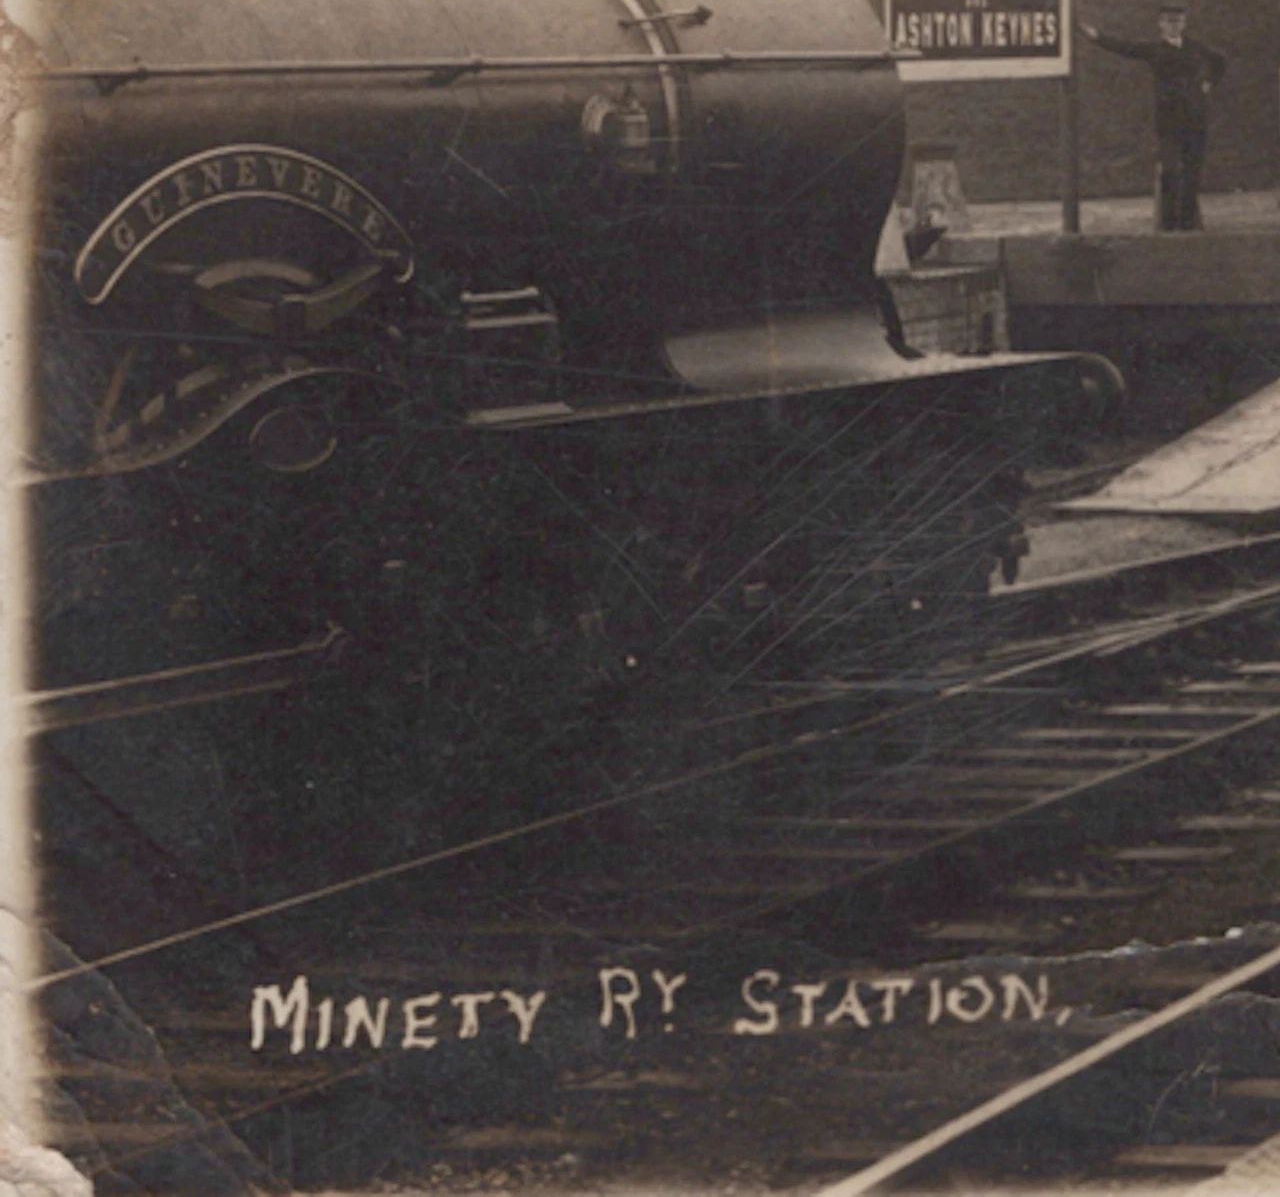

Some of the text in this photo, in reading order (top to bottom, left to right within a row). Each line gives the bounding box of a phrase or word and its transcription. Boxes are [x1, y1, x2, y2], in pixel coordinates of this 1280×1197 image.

[895, 11, 1057, 49] ASHTON KEYNES
[111, 155, 386, 253] GUINEVERE
